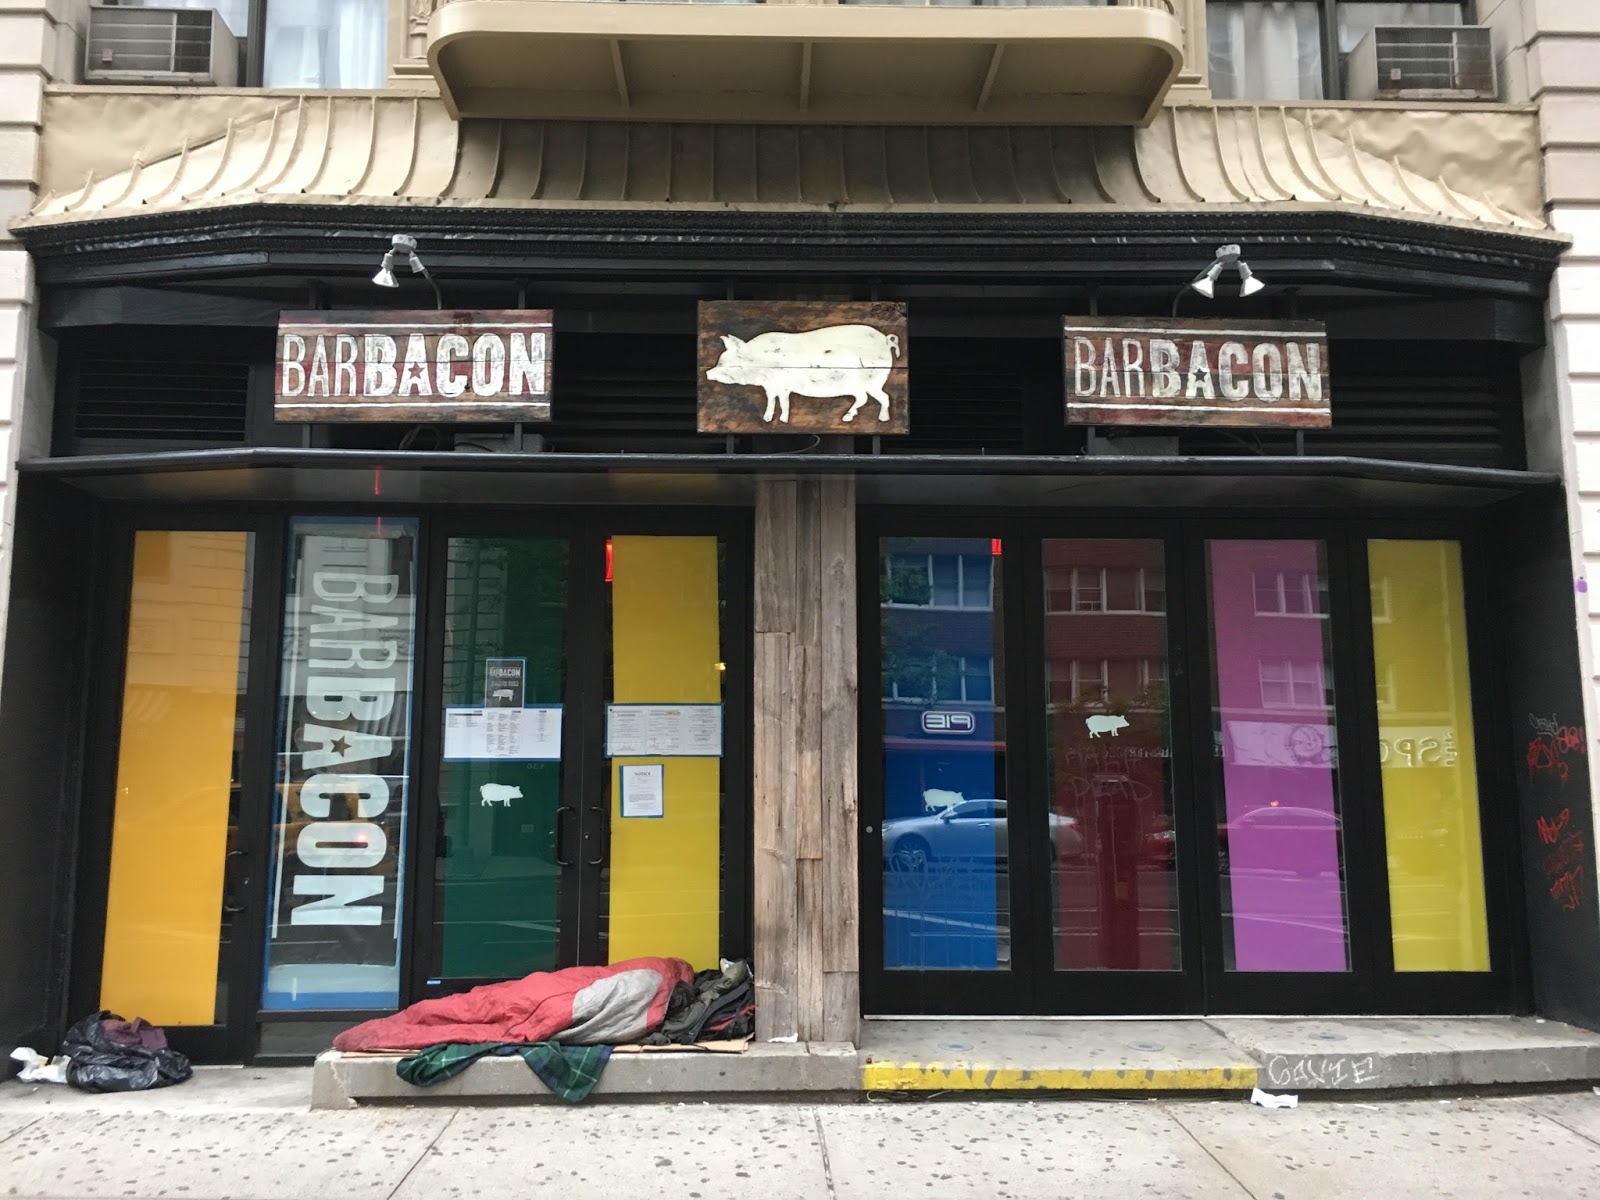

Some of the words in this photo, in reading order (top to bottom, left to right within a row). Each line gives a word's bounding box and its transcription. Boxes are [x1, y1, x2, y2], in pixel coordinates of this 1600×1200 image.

[281, 332, 546, 398] BARBACON
[1074, 335, 1323, 403] BARBACON
[290, 571, 400, 926] BARBACON
